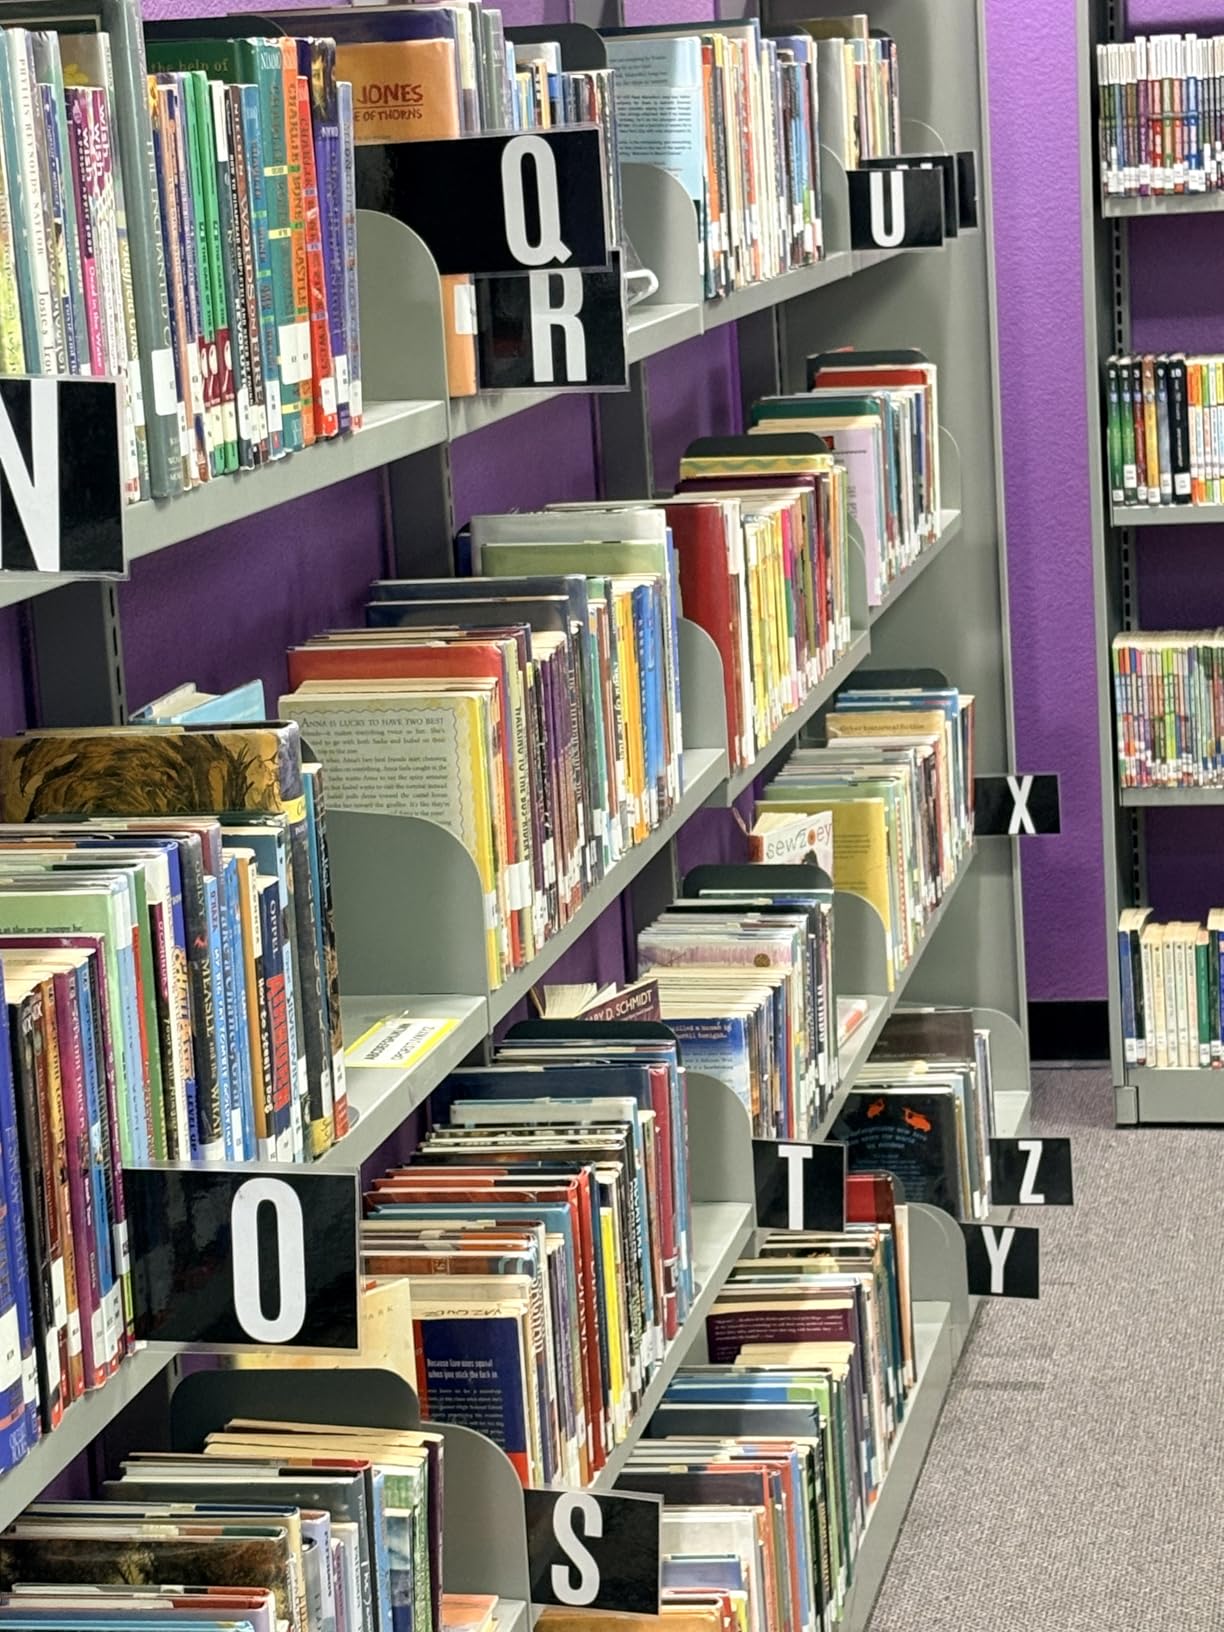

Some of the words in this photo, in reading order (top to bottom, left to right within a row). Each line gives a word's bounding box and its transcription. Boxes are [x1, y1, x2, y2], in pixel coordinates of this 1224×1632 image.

[19, 59, 32, 116] PHYLLIS
[215, 59, 231, 71] of
[356, 83, 424, 105] JONES
[363, 111, 376, 122] OF
[377, 108, 423, 121] THORNS
[83, 127, 93, 182] wish
[94, 123, 103, 176] wish
[99, 106, 108, 157] wish
[233, 104, 243, 176] NIELSEN
[25, 124, 38, 194] REYNOLDS
[232, 193, 241, 243] DISAPPEAR
[501, 135, 572, 266] Q
[870, 172, 906, 248] U
[33, 202, 45, 255] NAYLOR
[152, 189, 170, 319] ENCHANTED
[241, 194, 255, 300] WORDS
[89, 266, 98, 296] Dead
[236, 246, 246, 305] COMPLETELY
[92, 299, 98, 309] in
[249, 304, 257, 332] ON
[529, 270, 587, 382] R
[127, 319, 138, 360] Cross
[251, 338, 264, 403] FIRE
[0, 378, 60, 572] N
[1007, 776, 1036, 834] X
[195, 861, 205, 917] OGILVY
[220, 905, 232, 954] Take
[270, 900, 279, 959] OPPEL
[214, 948, 220, 966] MY
[201, 959, 215, 1037] MEASLE
[217, 1000, 225, 1020] FAT
[225, 976, 239, 1060] Chance,
[261, 1012, 269, 1029] to
[605, 1007, 615, 1020] D.
[615, 989, 653, 1017] SCHMIDT
[208, 1042, 216, 1059] and
[210, 1062, 218, 1079] the
[220, 1025, 228, 1078] ZOMBIE
[262, 1034, 271, 1070] Steal
[188, 1094, 196, 1130] LEVEL
[223, 1083, 231, 1146] GOLDFISH
[264, 1087, 274, 1114] Dog
[190, 1134, 198, 1152] UP
[778, 1145, 813, 1230] T
[1018, 1141, 1045, 1203] Z
[231, 1177, 306, 1343] O
[982, 1227, 1015, 1293] Y
[551, 1493, 603, 1606] S
